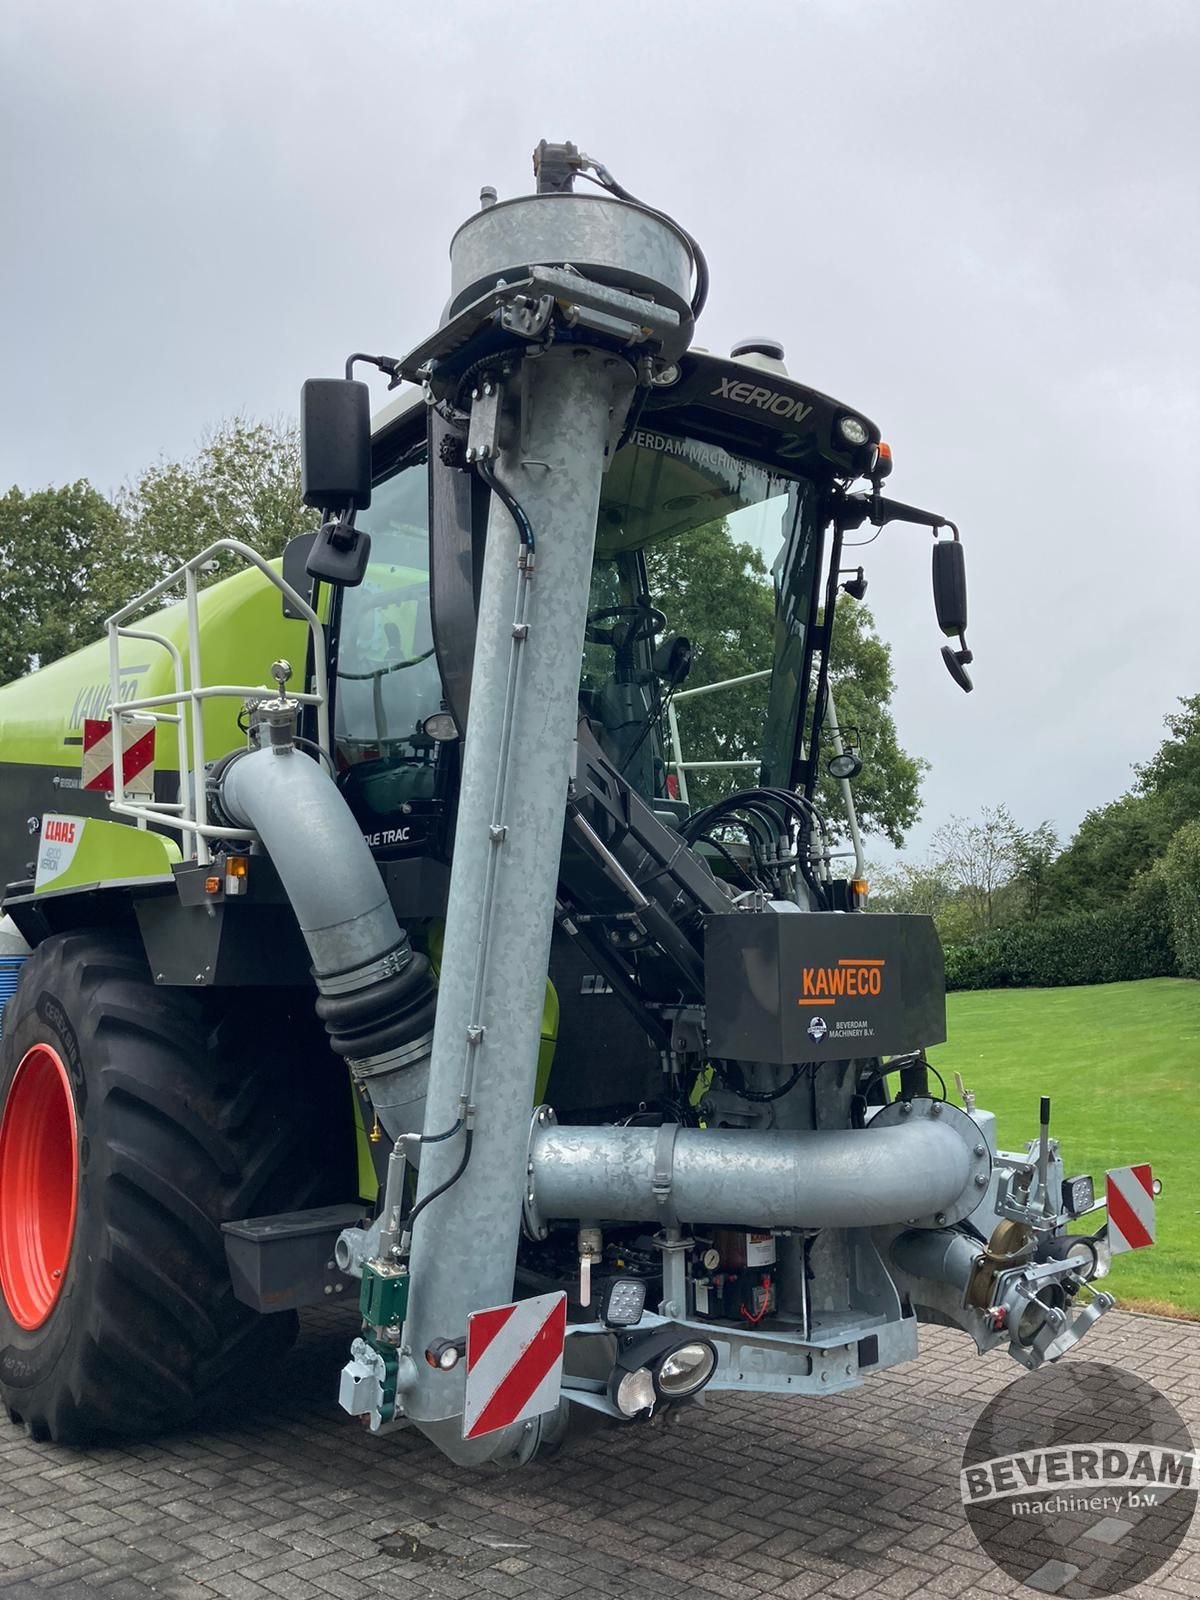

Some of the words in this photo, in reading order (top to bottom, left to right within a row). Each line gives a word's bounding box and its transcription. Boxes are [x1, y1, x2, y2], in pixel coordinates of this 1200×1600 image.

[710, 378, 812, 423] XERION
[45, 821, 76, 844] CLAAS
[382, 826, 411, 844] TRAC
[802, 968, 881, 996] KAWECO
[829, 1029, 863, 1038] MACHINERY
[864, 1028, 875, 1036] B.V.
[836, 1020, 868, 1029] BEVERDAM
